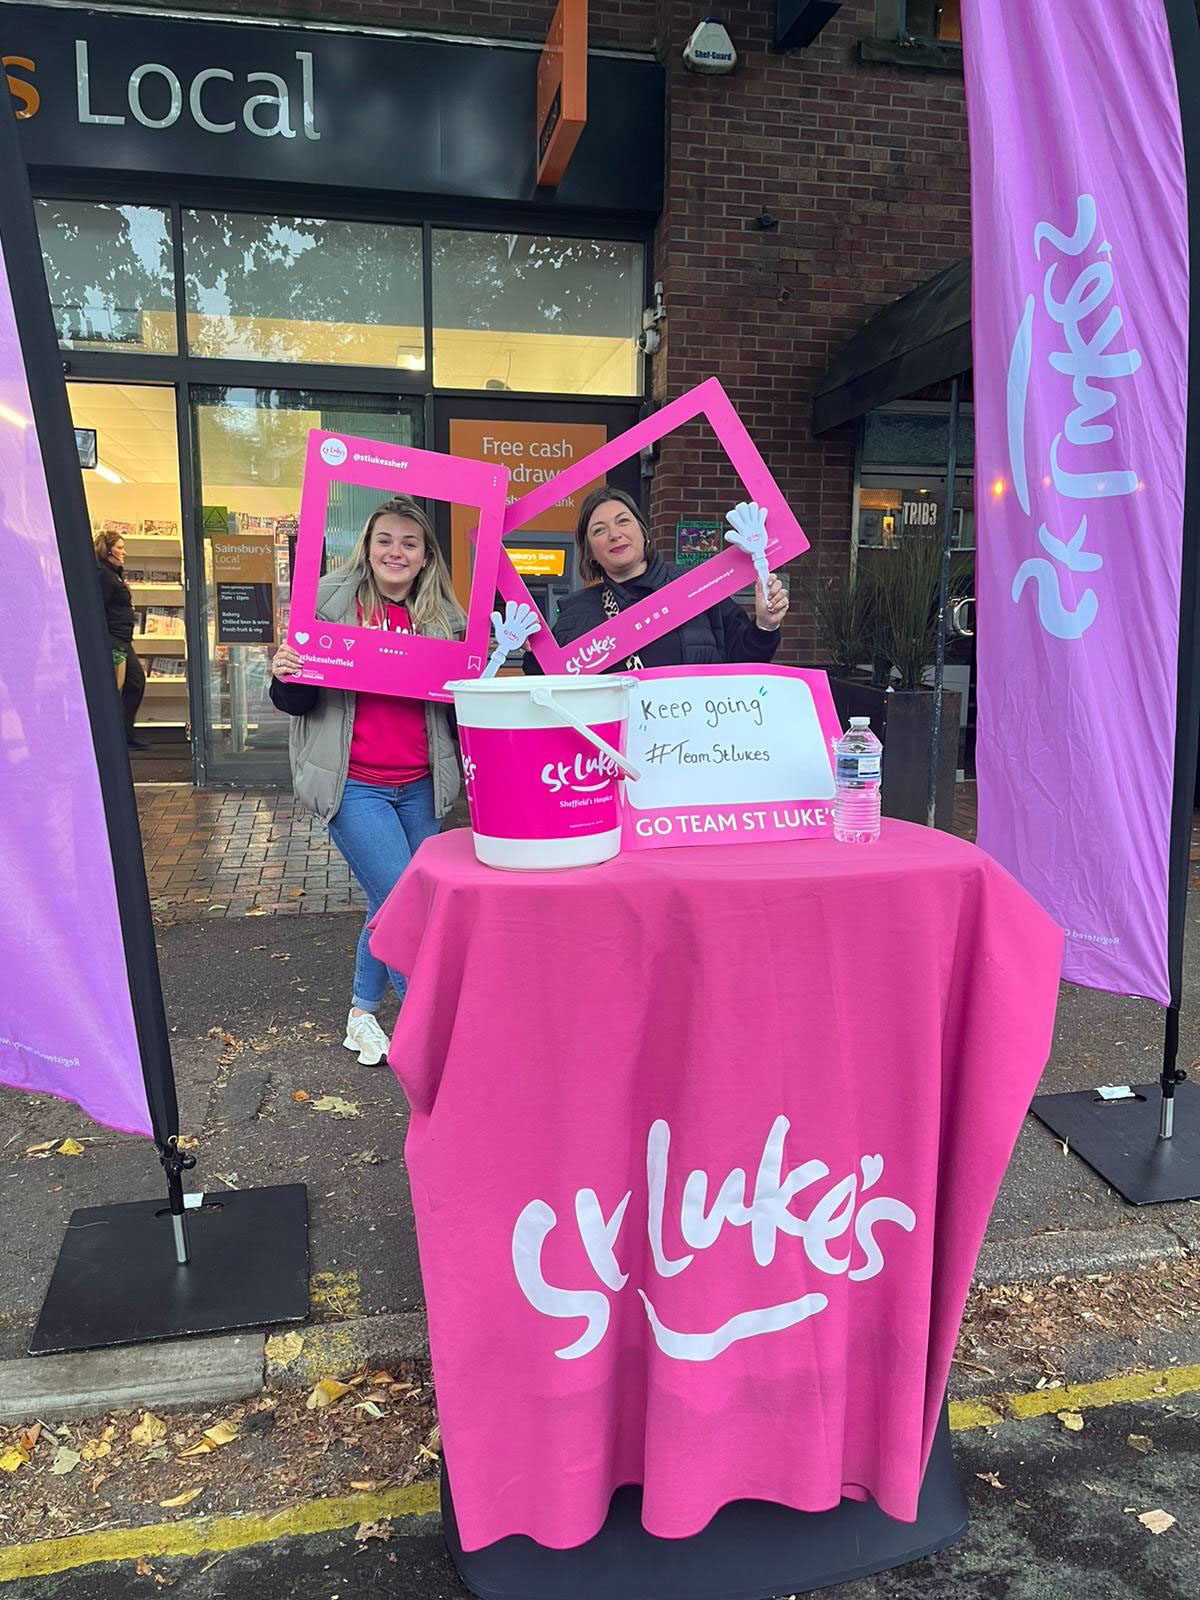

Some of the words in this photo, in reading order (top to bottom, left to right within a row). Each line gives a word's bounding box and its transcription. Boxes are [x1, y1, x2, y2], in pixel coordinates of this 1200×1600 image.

[694, 49, 732, 61] Shef-Guard
[75, 39, 321, 140] Local
[482, 436, 524, 457] Free
[529, 439, 574, 459] cash
[555, 497, 575, 508] ank
[903, 502, 938, 526] TRIB3
[214, 544, 272, 556] Sainsbury's
[215, 554, 240, 564] Local
[560, 798, 593, 808] Sheffield's
[636, 817, 673, 836] GO
[676, 813, 737, 833] TEAM
[742, 811, 767, 830] ST
[773, 808, 836, 828] LUKE'
[512, 1188, 632, 1359] St
[646, 1115, 916, 1281] Luke's
